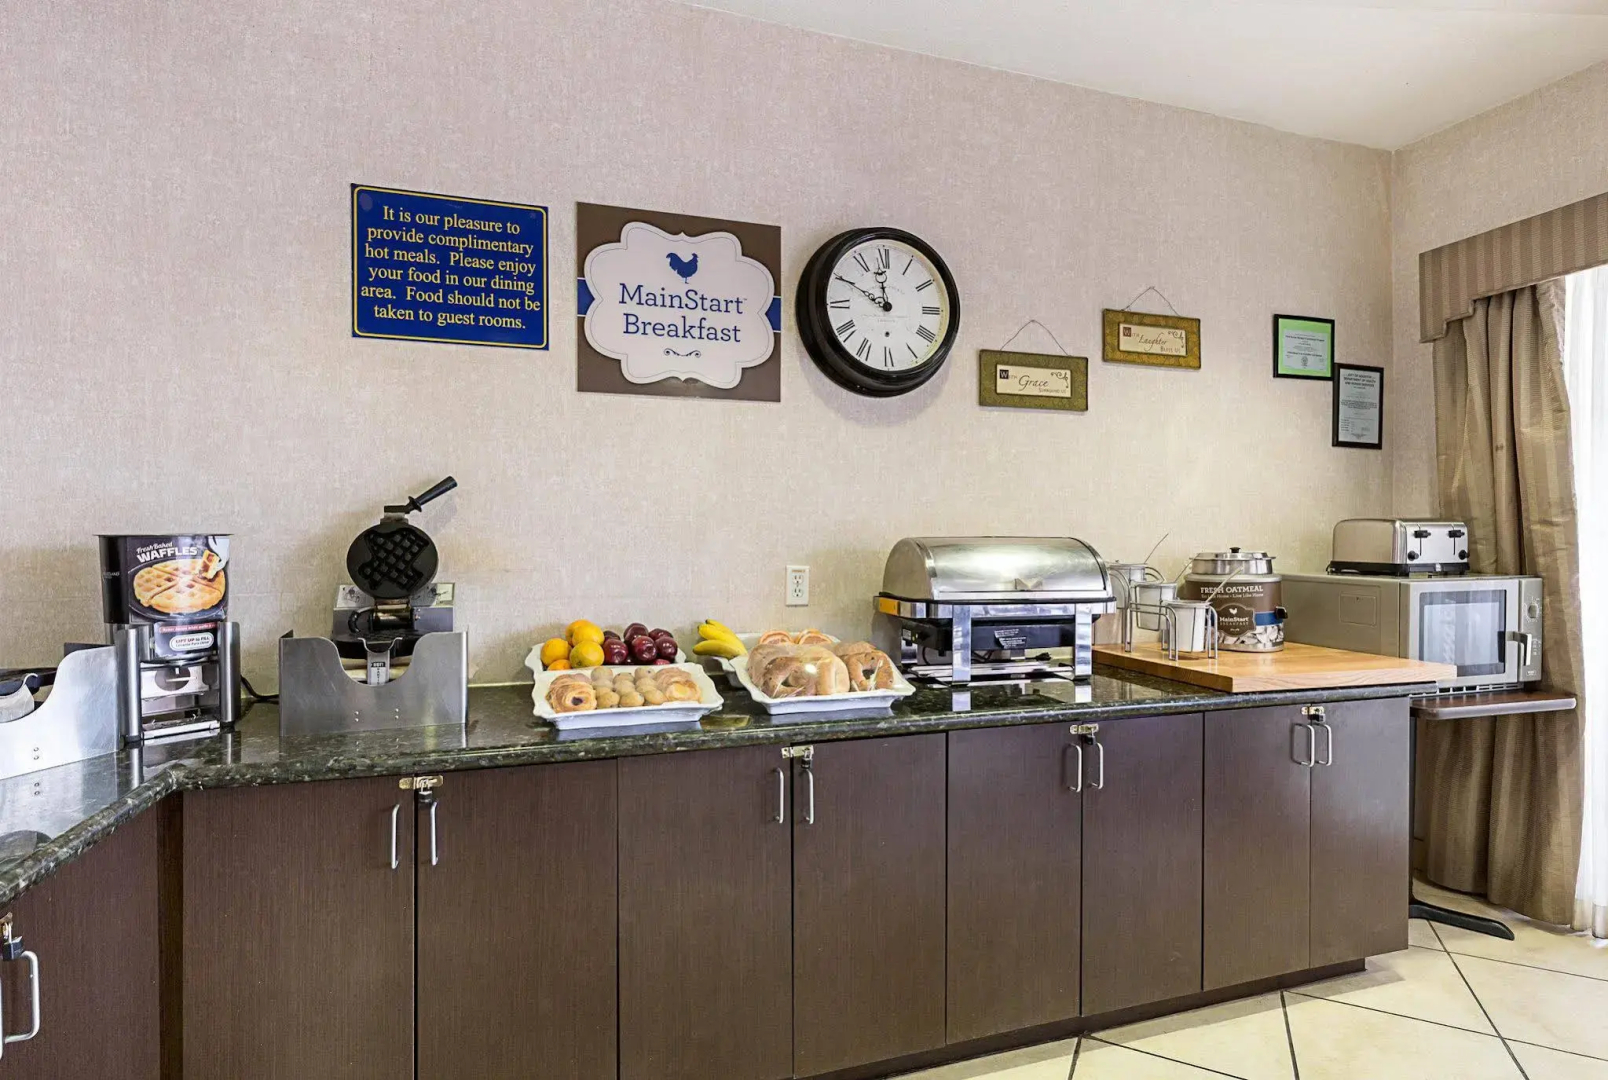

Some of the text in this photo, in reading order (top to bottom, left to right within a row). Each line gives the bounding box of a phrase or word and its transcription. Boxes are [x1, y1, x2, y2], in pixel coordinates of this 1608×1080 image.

[383, 206, 520, 234] It is our pleasure to
[367, 227, 534, 257] provide complimentary
[365, 243, 536, 276] hot meals. Please enjoy
[369, 266, 535, 295] your food in our dining
[361, 286, 541, 311] area. Food should not be
[618, 283, 744, 314] MainStart
[374, 304, 526, 329] taken to guest rooms.
[623, 313, 741, 342] Breakfast
[1019, 375, 1049, 391] Grace
[136, 546, 198, 563] WAFFLES
[152, 541, 173, 549] Baked
[1225, 585, 1264, 594] OATMEAL
